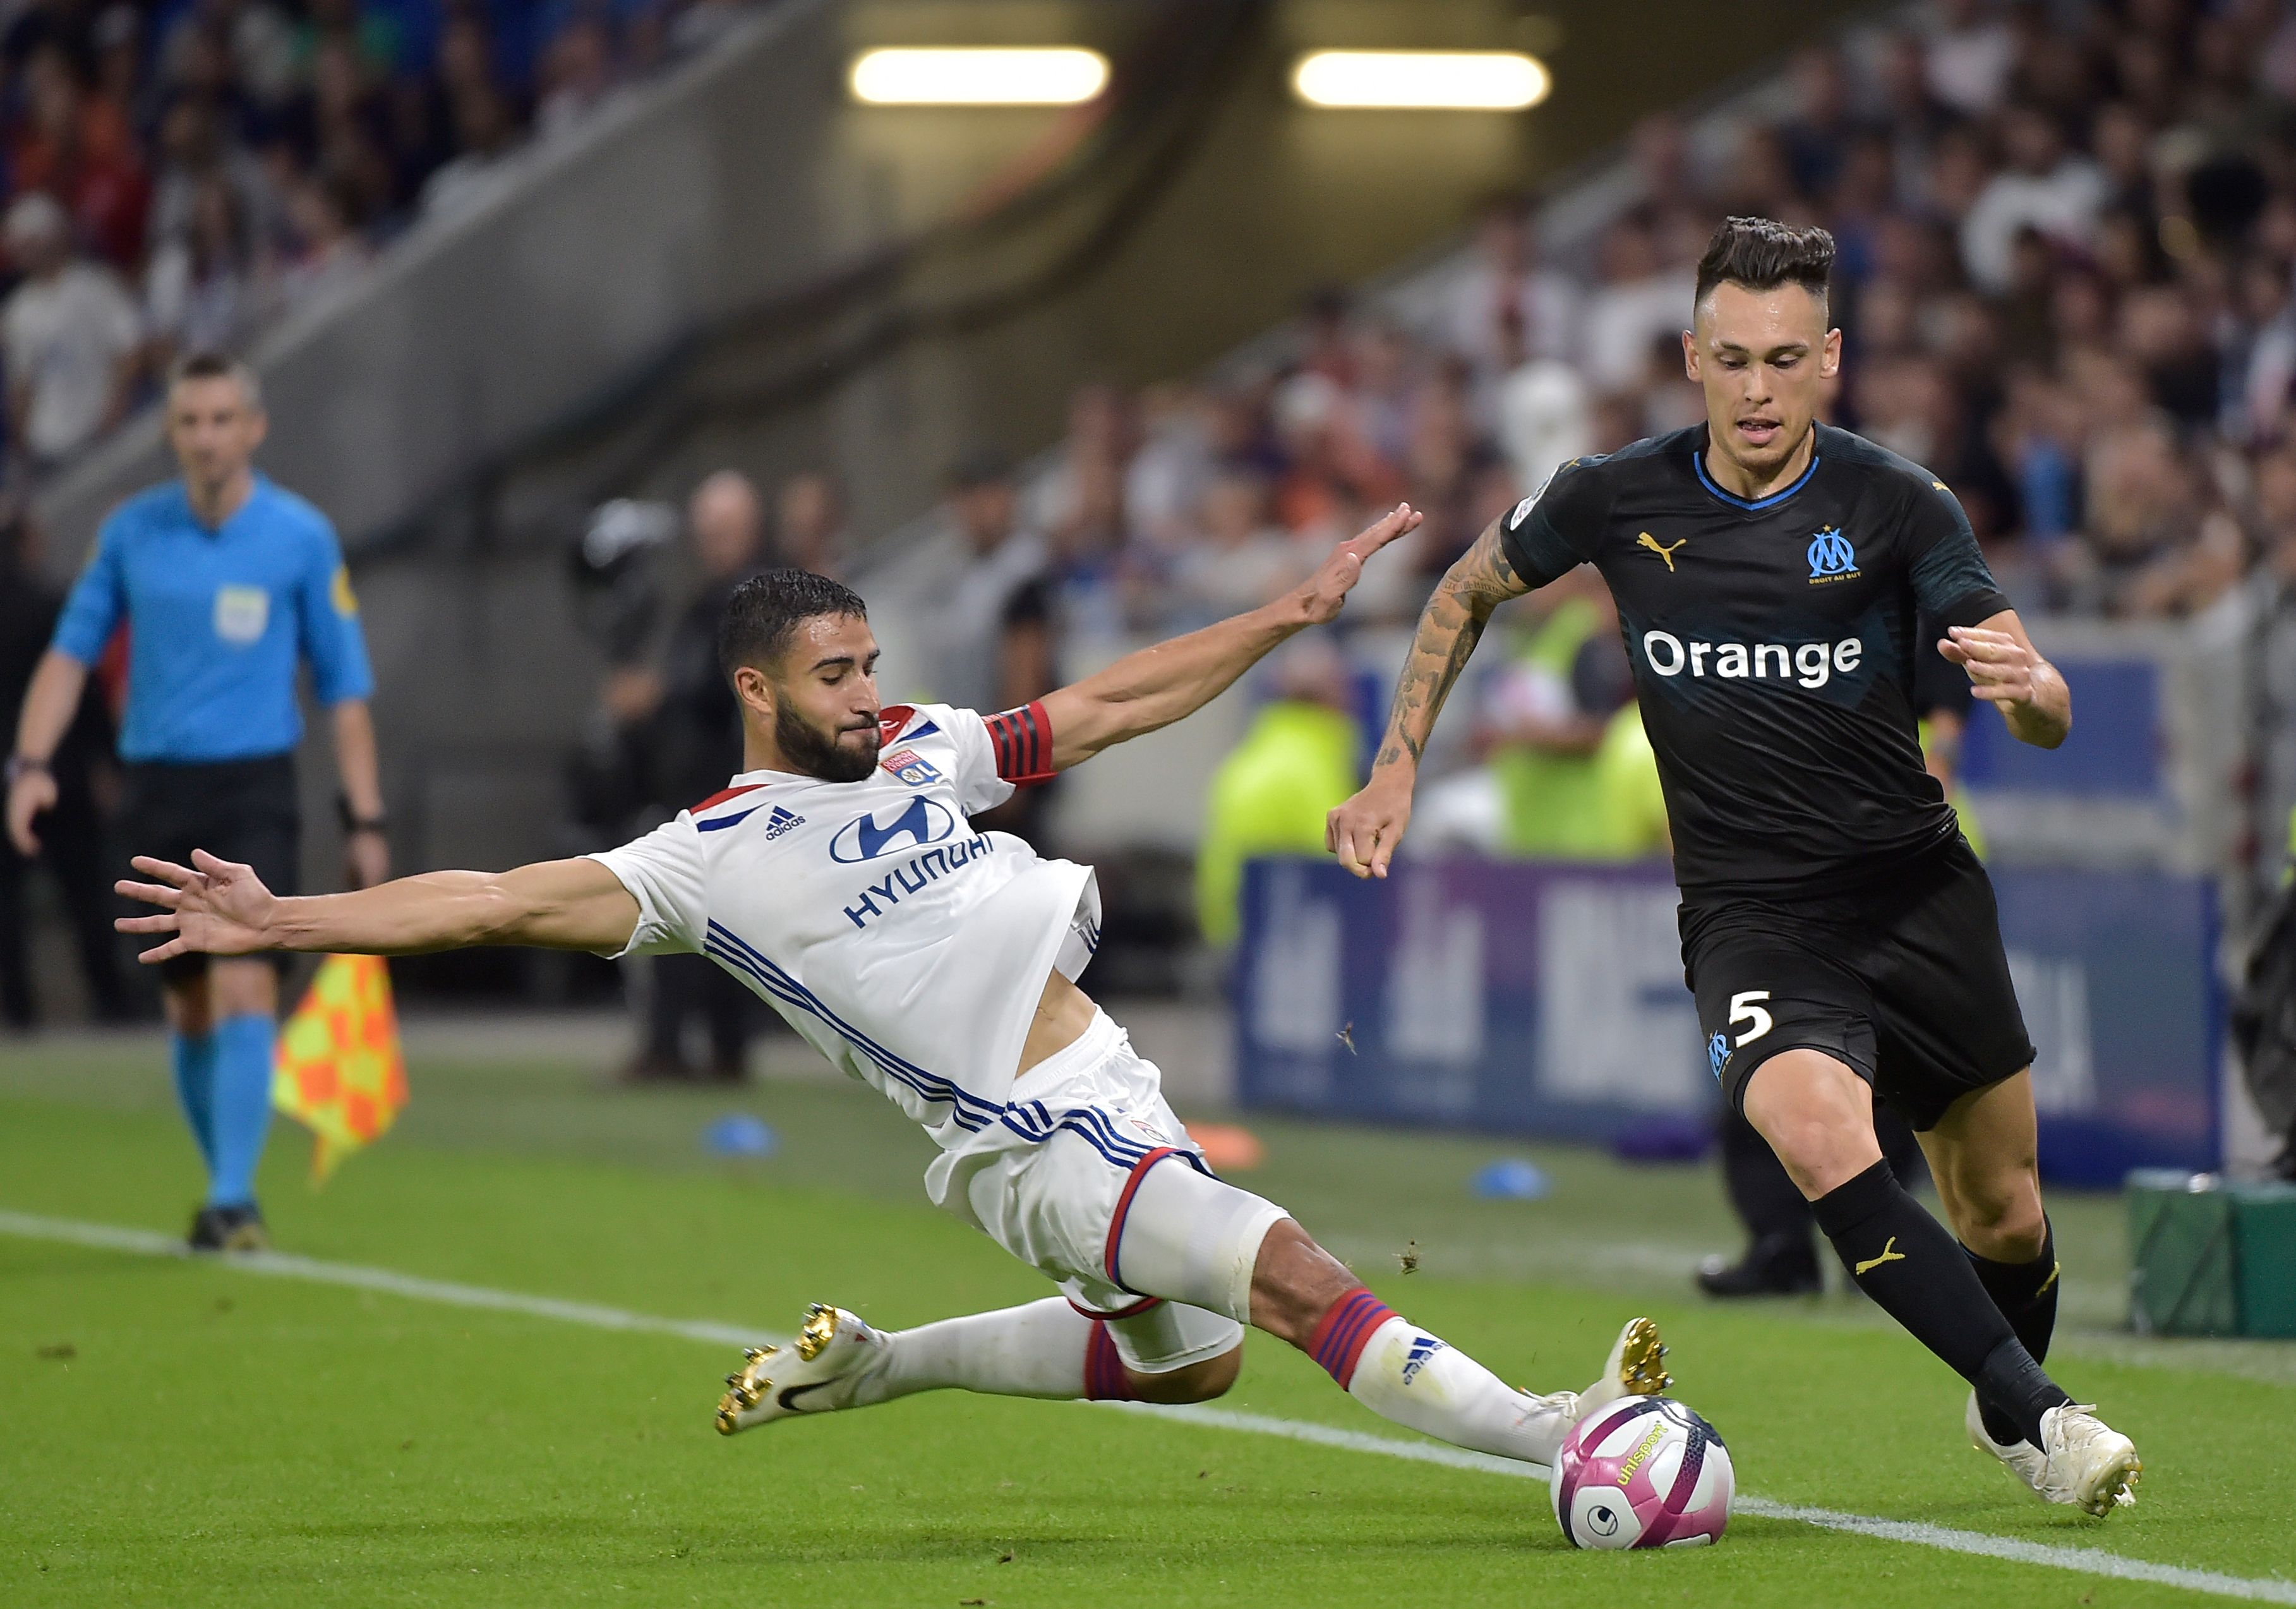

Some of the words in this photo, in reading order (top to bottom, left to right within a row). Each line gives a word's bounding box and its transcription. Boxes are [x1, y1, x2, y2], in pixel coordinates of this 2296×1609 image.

[1808, 576, 1832, 584] DROIT
[1644, 630, 1862, 689] Orange
[766, 816, 806, 841] adidas
[1729, 991, 1773, 1049] 5
[1617, 1424, 1669, 1486] uhlsport
